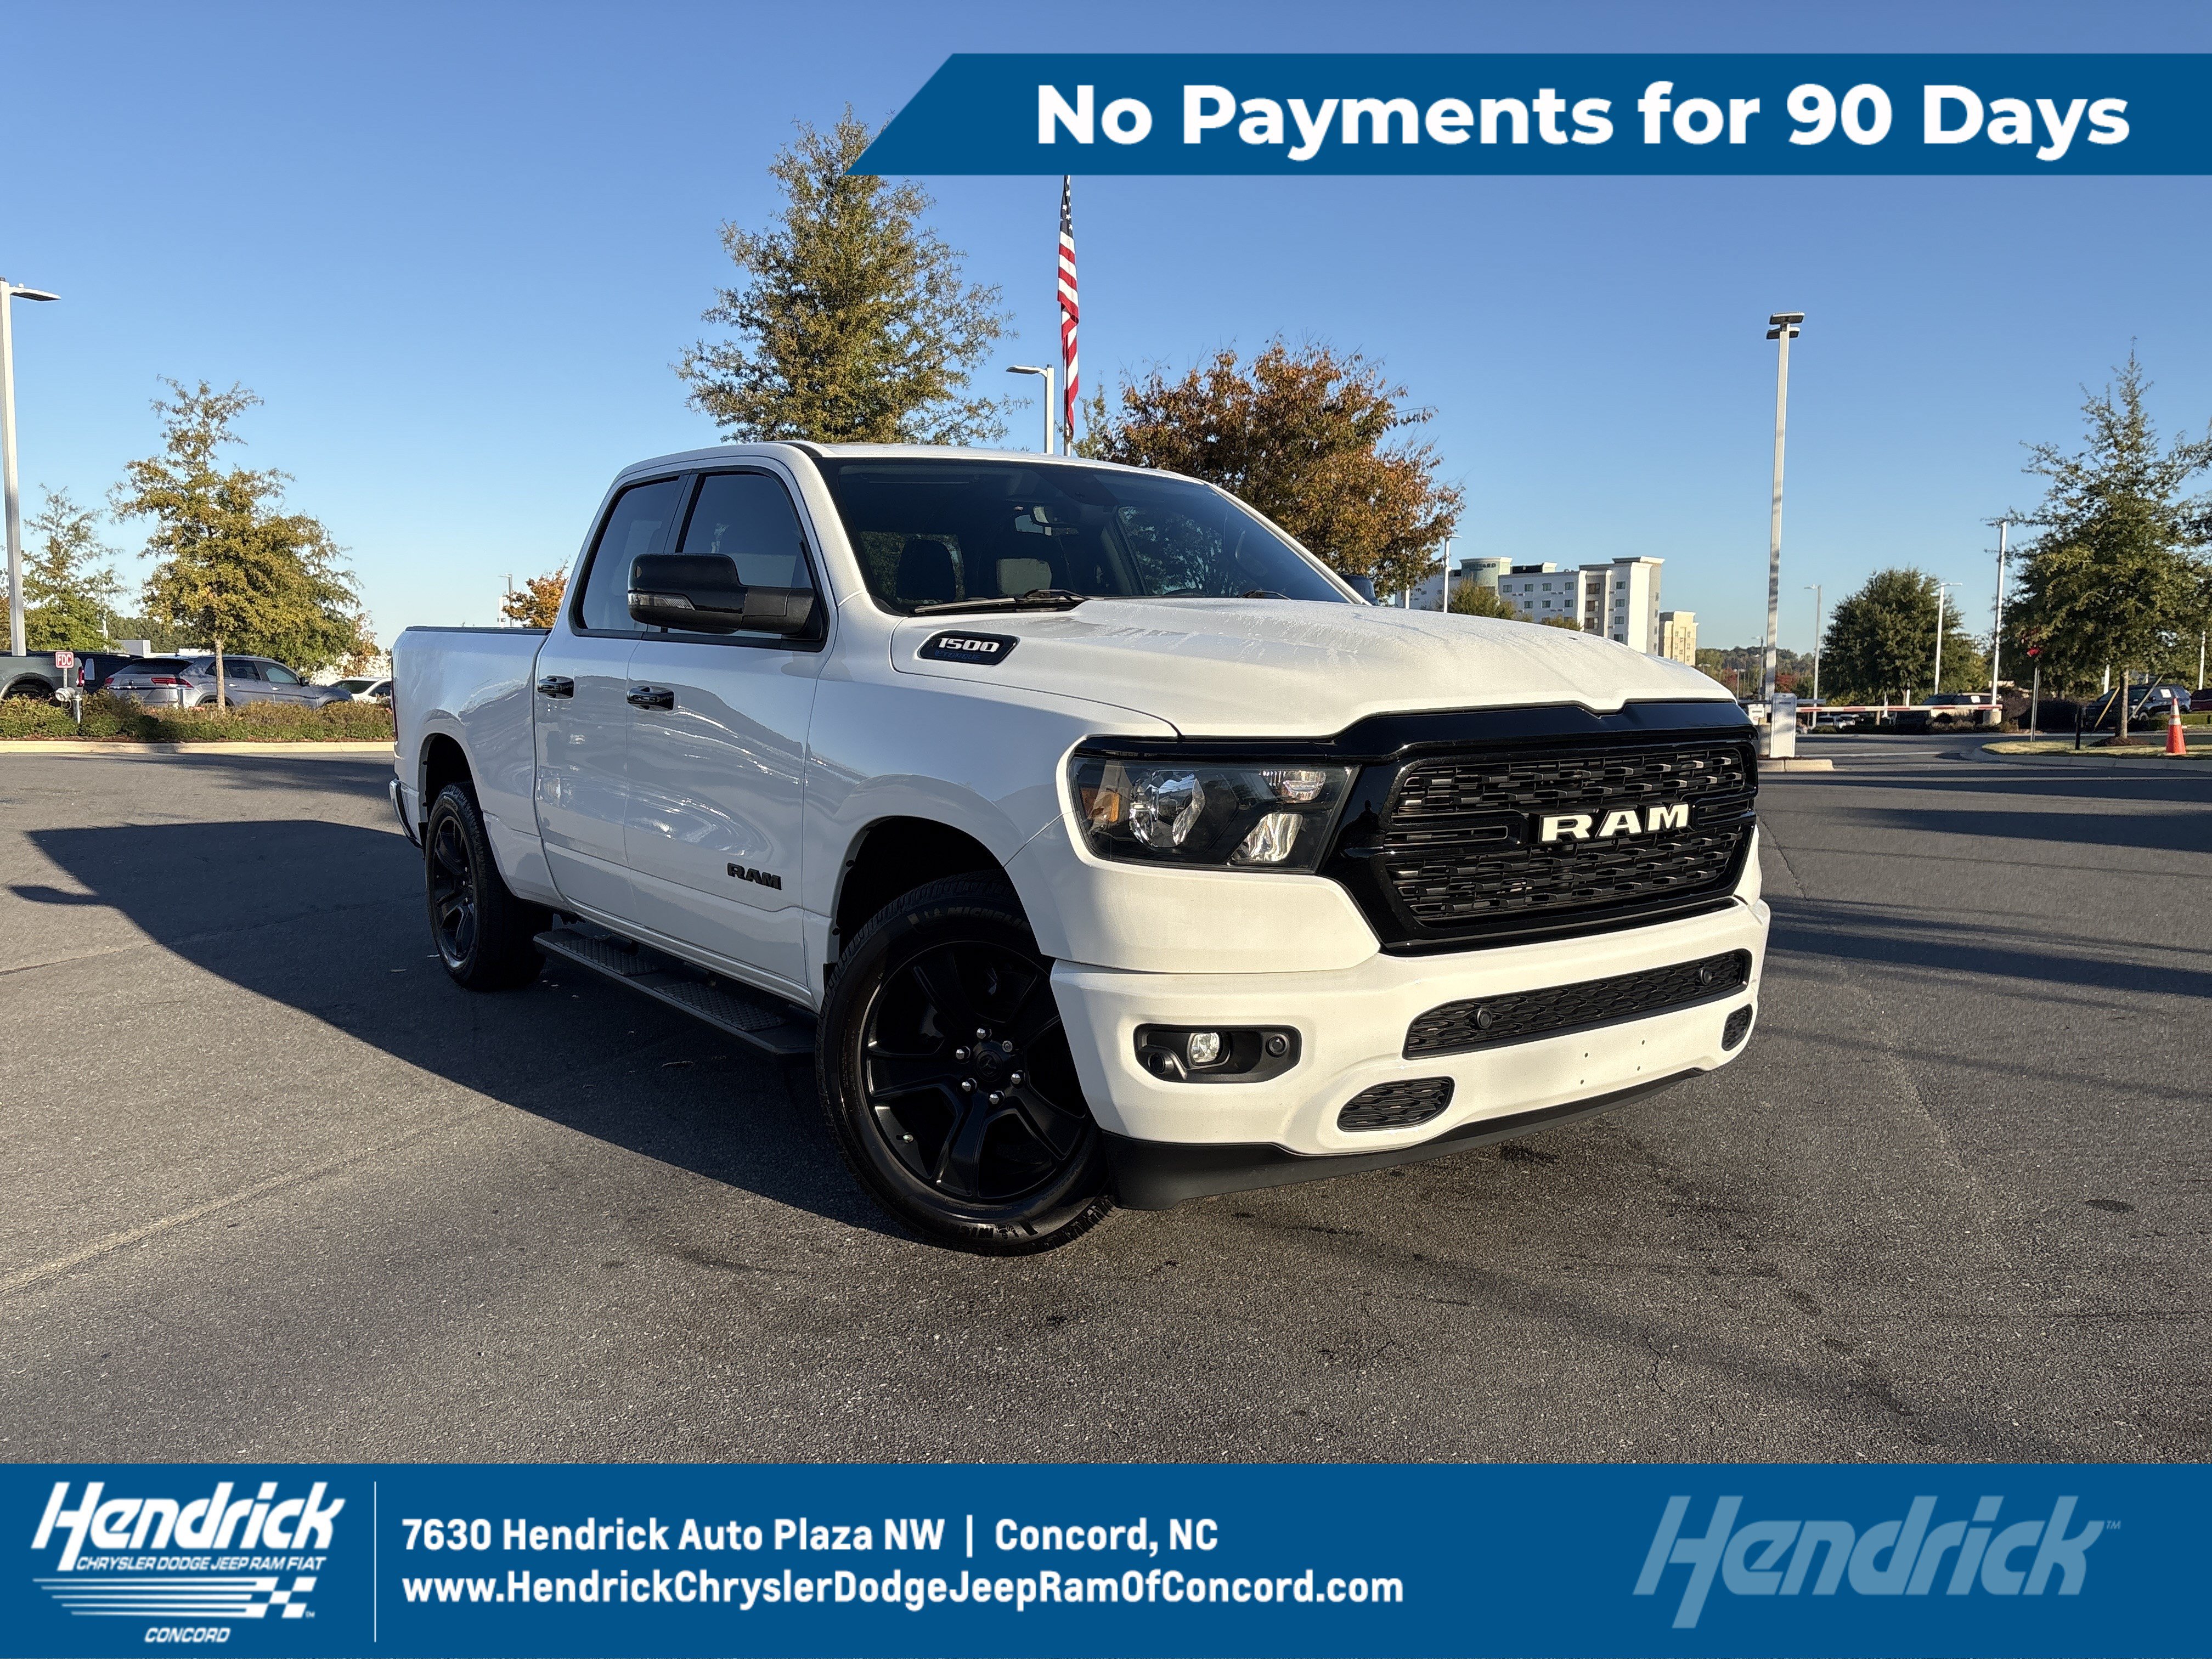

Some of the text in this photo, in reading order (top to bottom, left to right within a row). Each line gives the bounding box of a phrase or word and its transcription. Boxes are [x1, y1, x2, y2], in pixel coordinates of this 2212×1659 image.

[939, 637, 1000, 652] 1500
[57, 653, 72, 665] FDC
[1539, 803, 1689, 843] RAM
[727, 862, 782, 890] RAM
